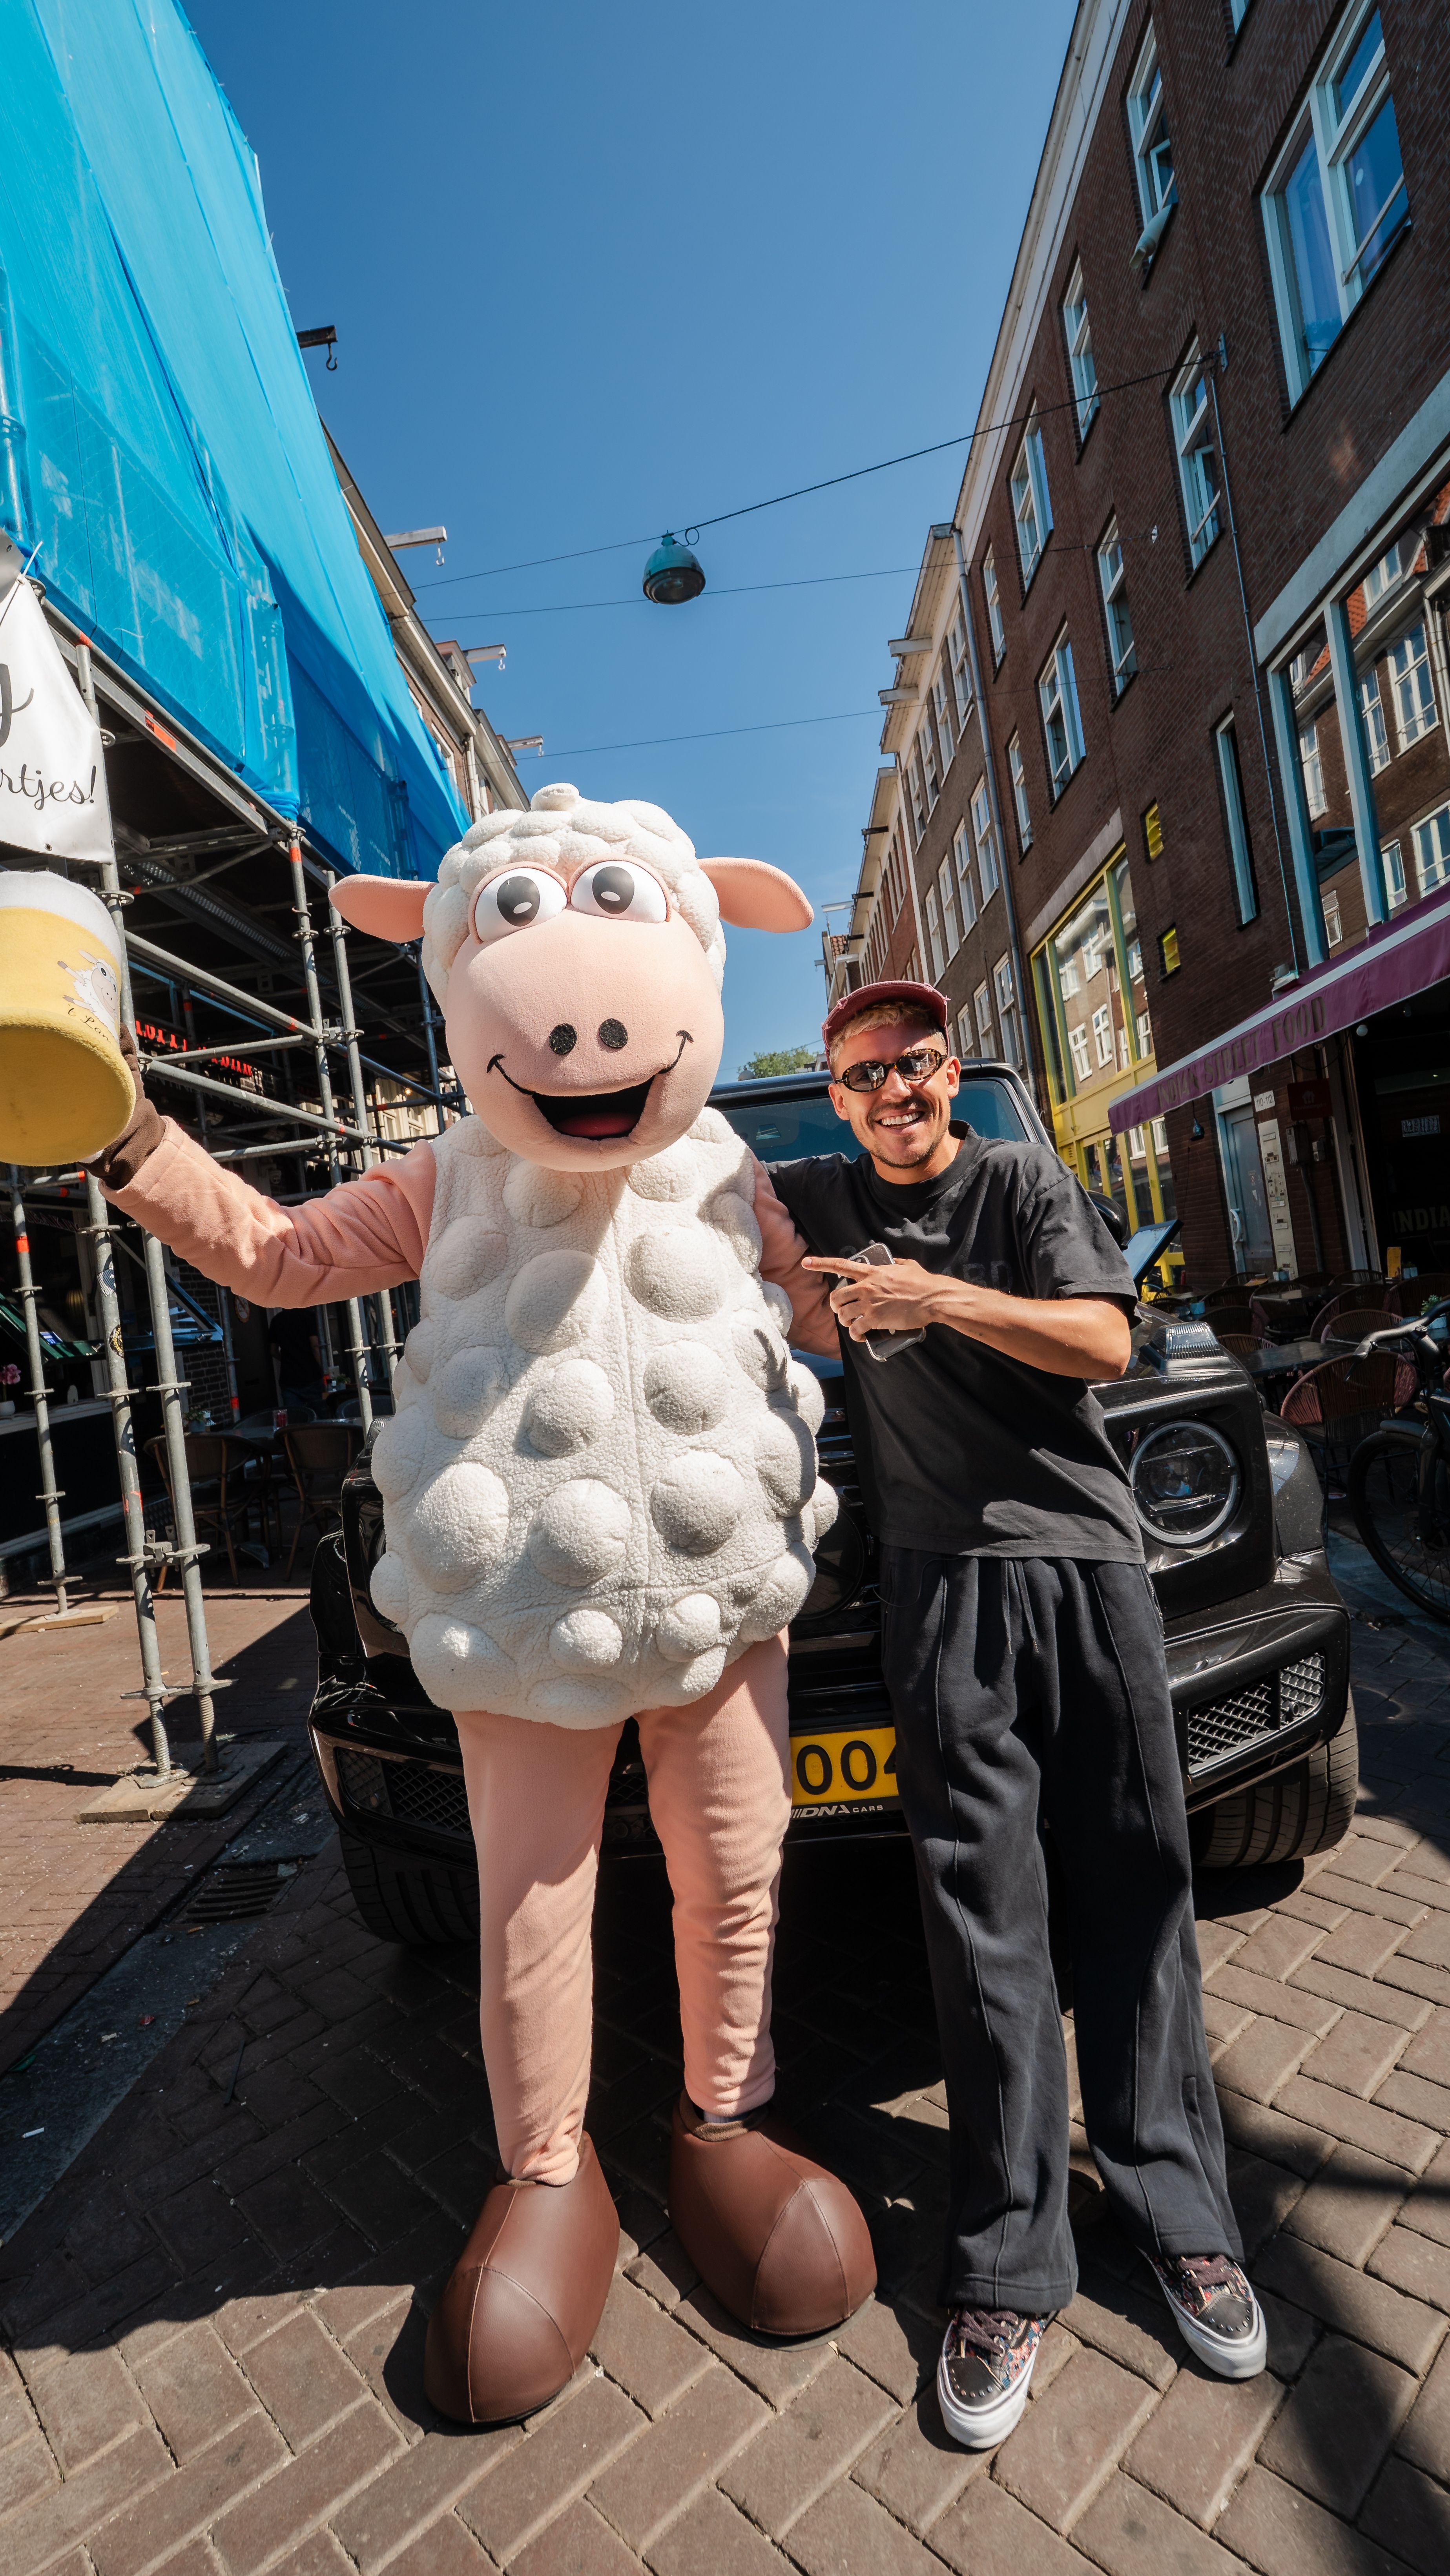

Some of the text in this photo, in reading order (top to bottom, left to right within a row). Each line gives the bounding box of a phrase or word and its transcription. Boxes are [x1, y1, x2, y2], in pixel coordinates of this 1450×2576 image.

[1156, 996, 1328, 1110] INDIAN STREET FOOD
[800, 1805, 884, 1818] DNA CARS
